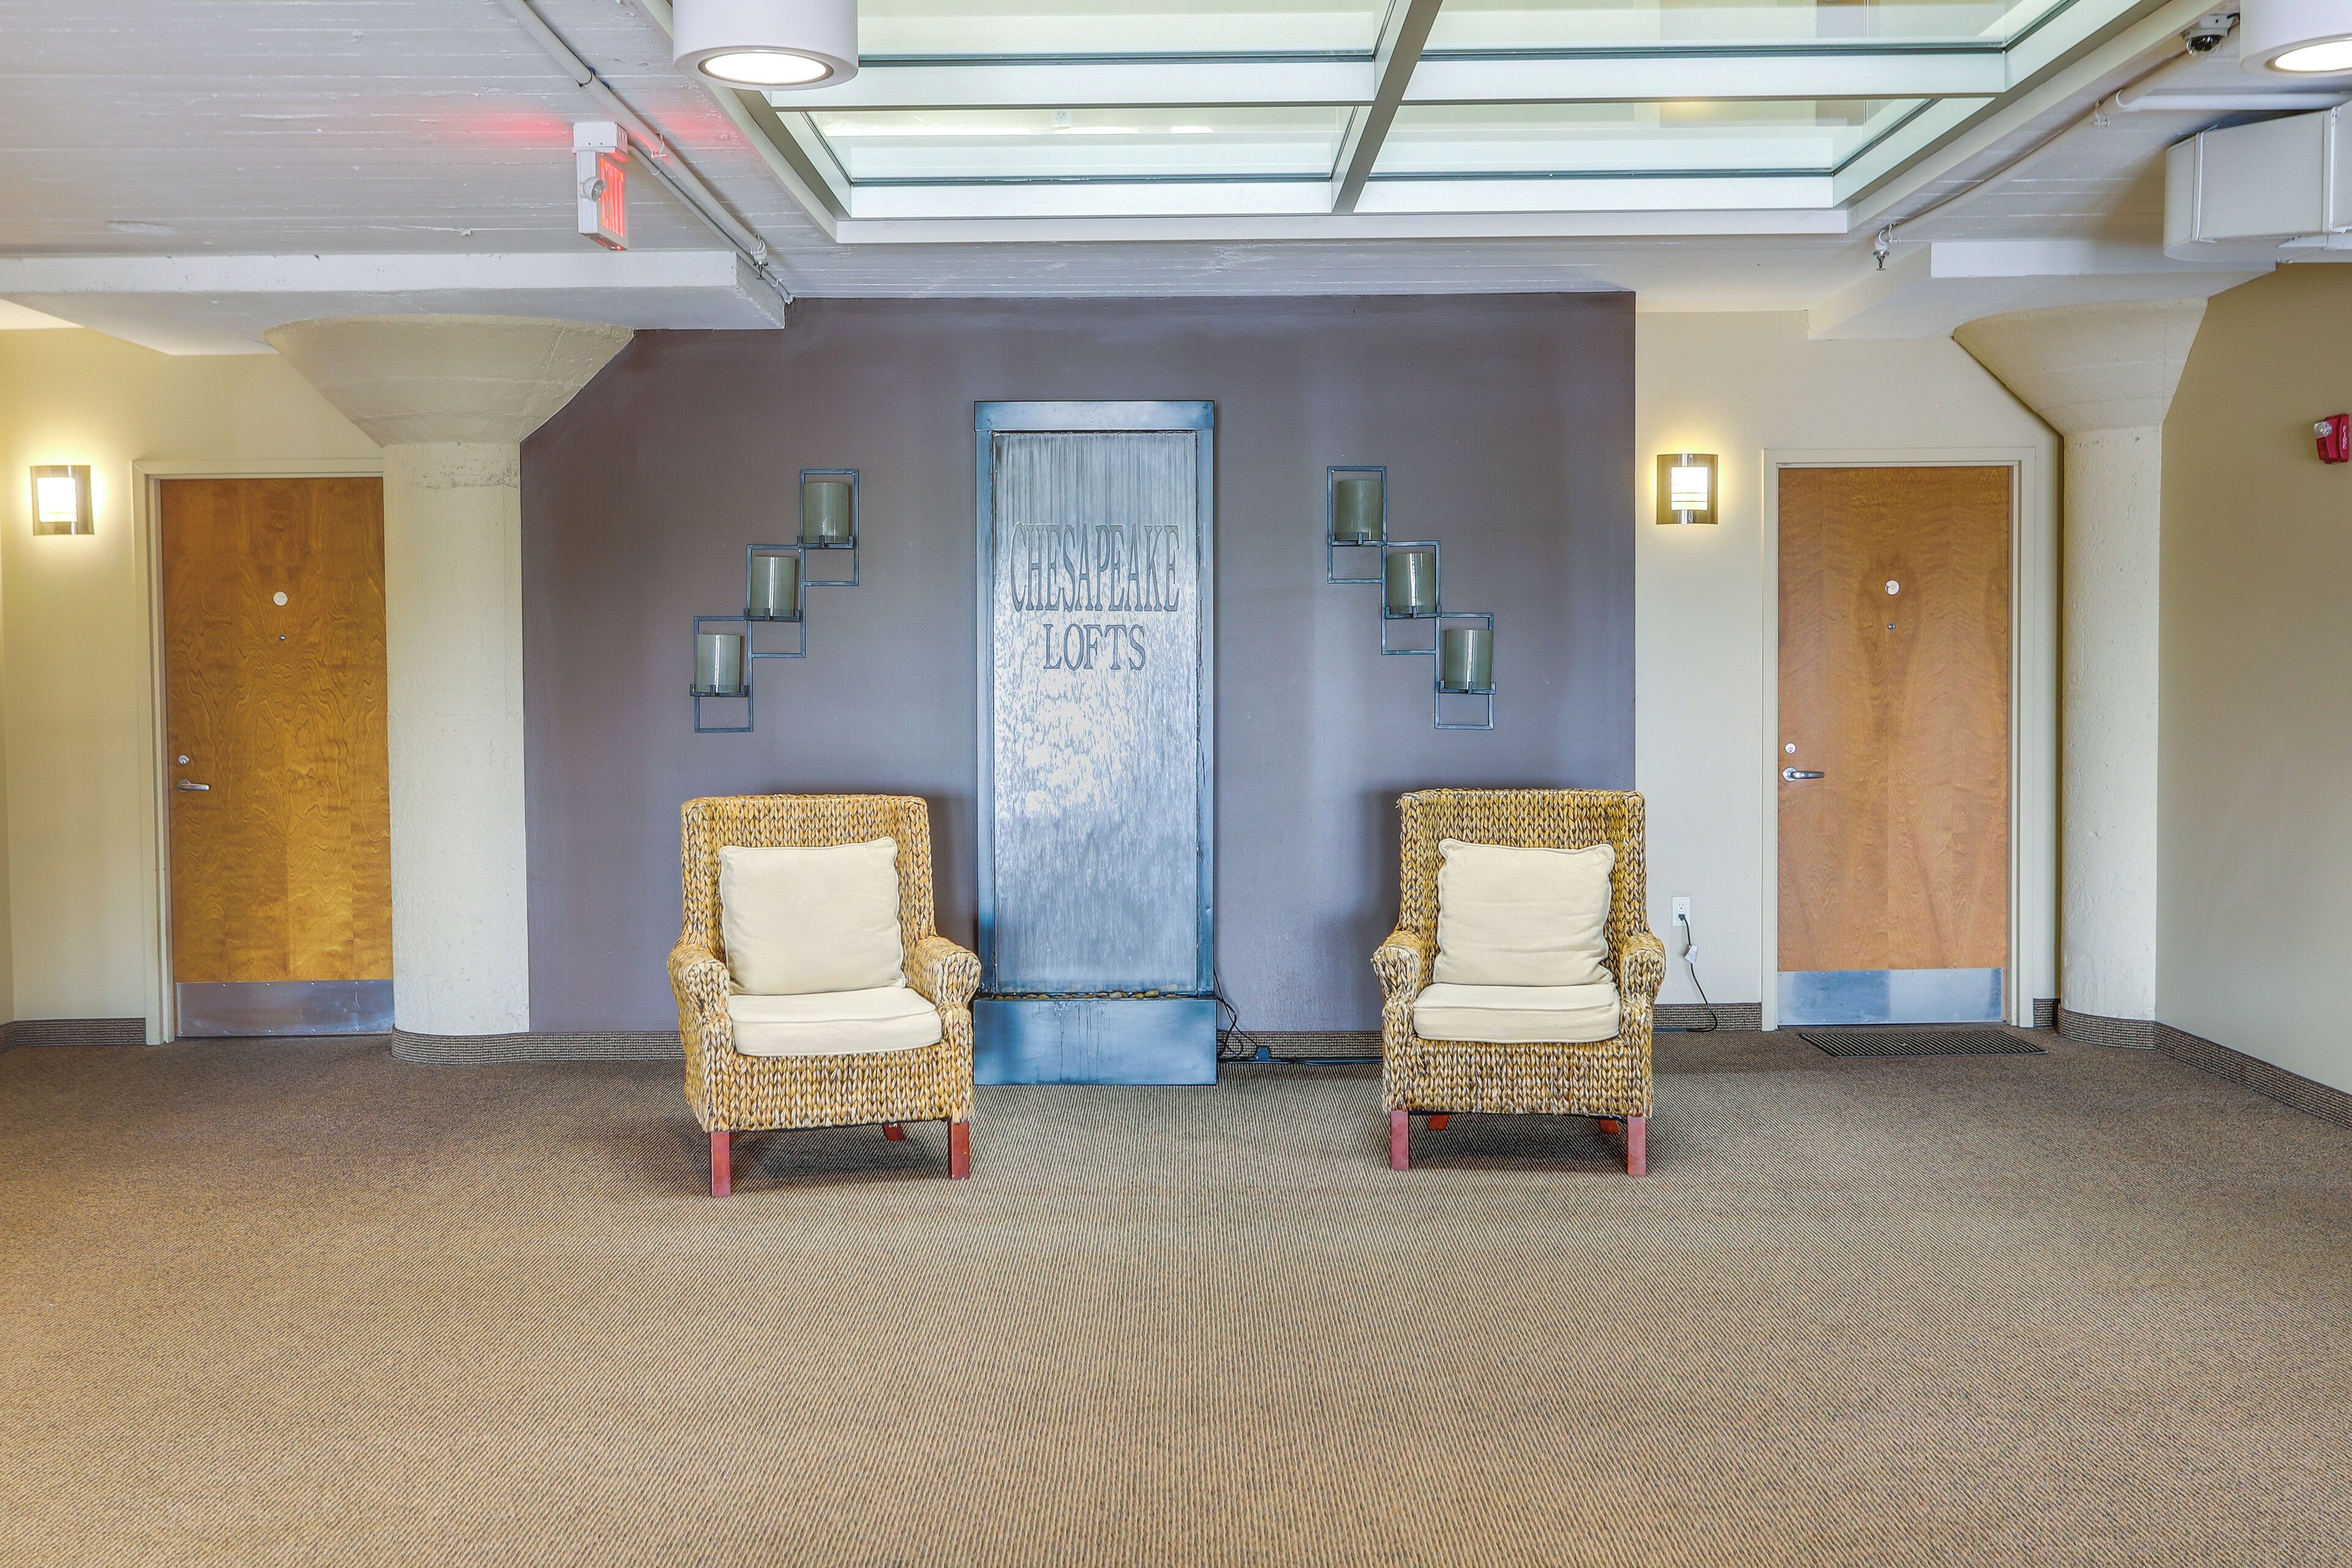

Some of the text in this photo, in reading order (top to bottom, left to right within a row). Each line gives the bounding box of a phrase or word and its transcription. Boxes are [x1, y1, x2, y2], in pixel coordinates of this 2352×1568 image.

[600, 157, 625, 238] EXIT
[1011, 522, 1180, 612] CHESAPEAKE
[1043, 623, 1146, 671] LOFTS
